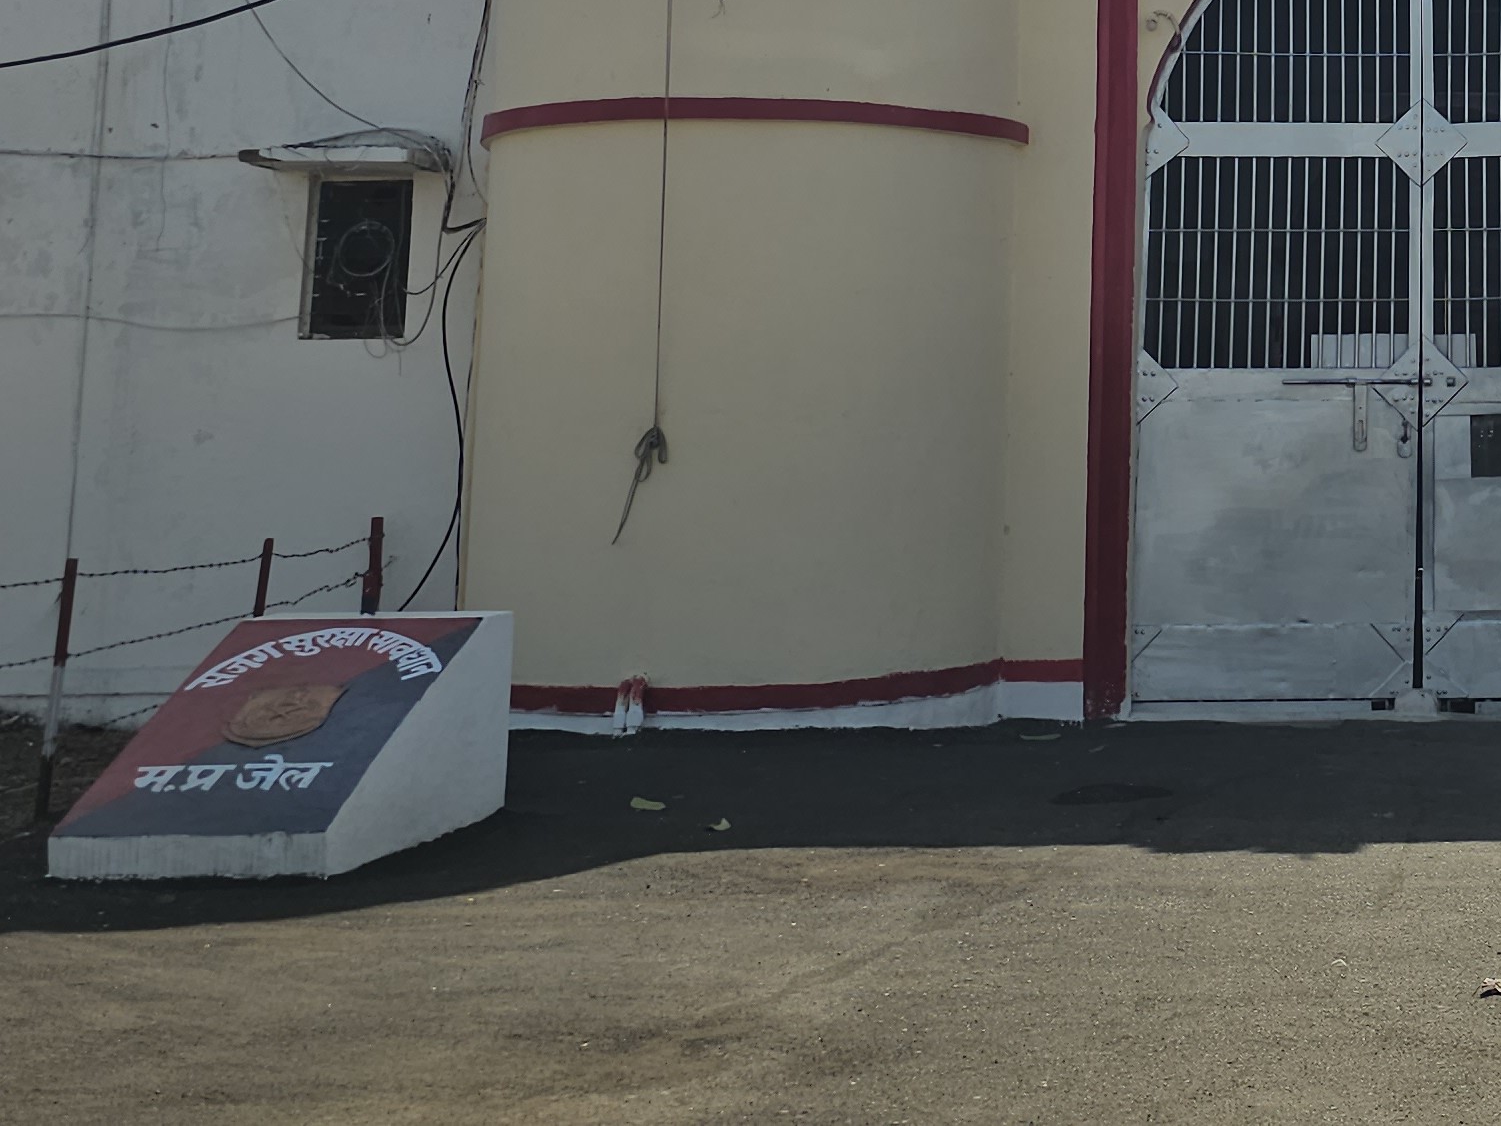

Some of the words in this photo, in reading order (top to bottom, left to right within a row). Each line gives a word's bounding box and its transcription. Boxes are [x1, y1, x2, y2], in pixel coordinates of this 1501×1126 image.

[184, 641, 284, 691] सजग
[278, 627, 380, 657] सुरक्षा
[366, 630, 443, 681] सावधान
[235, 753, 334, 791] जेल
